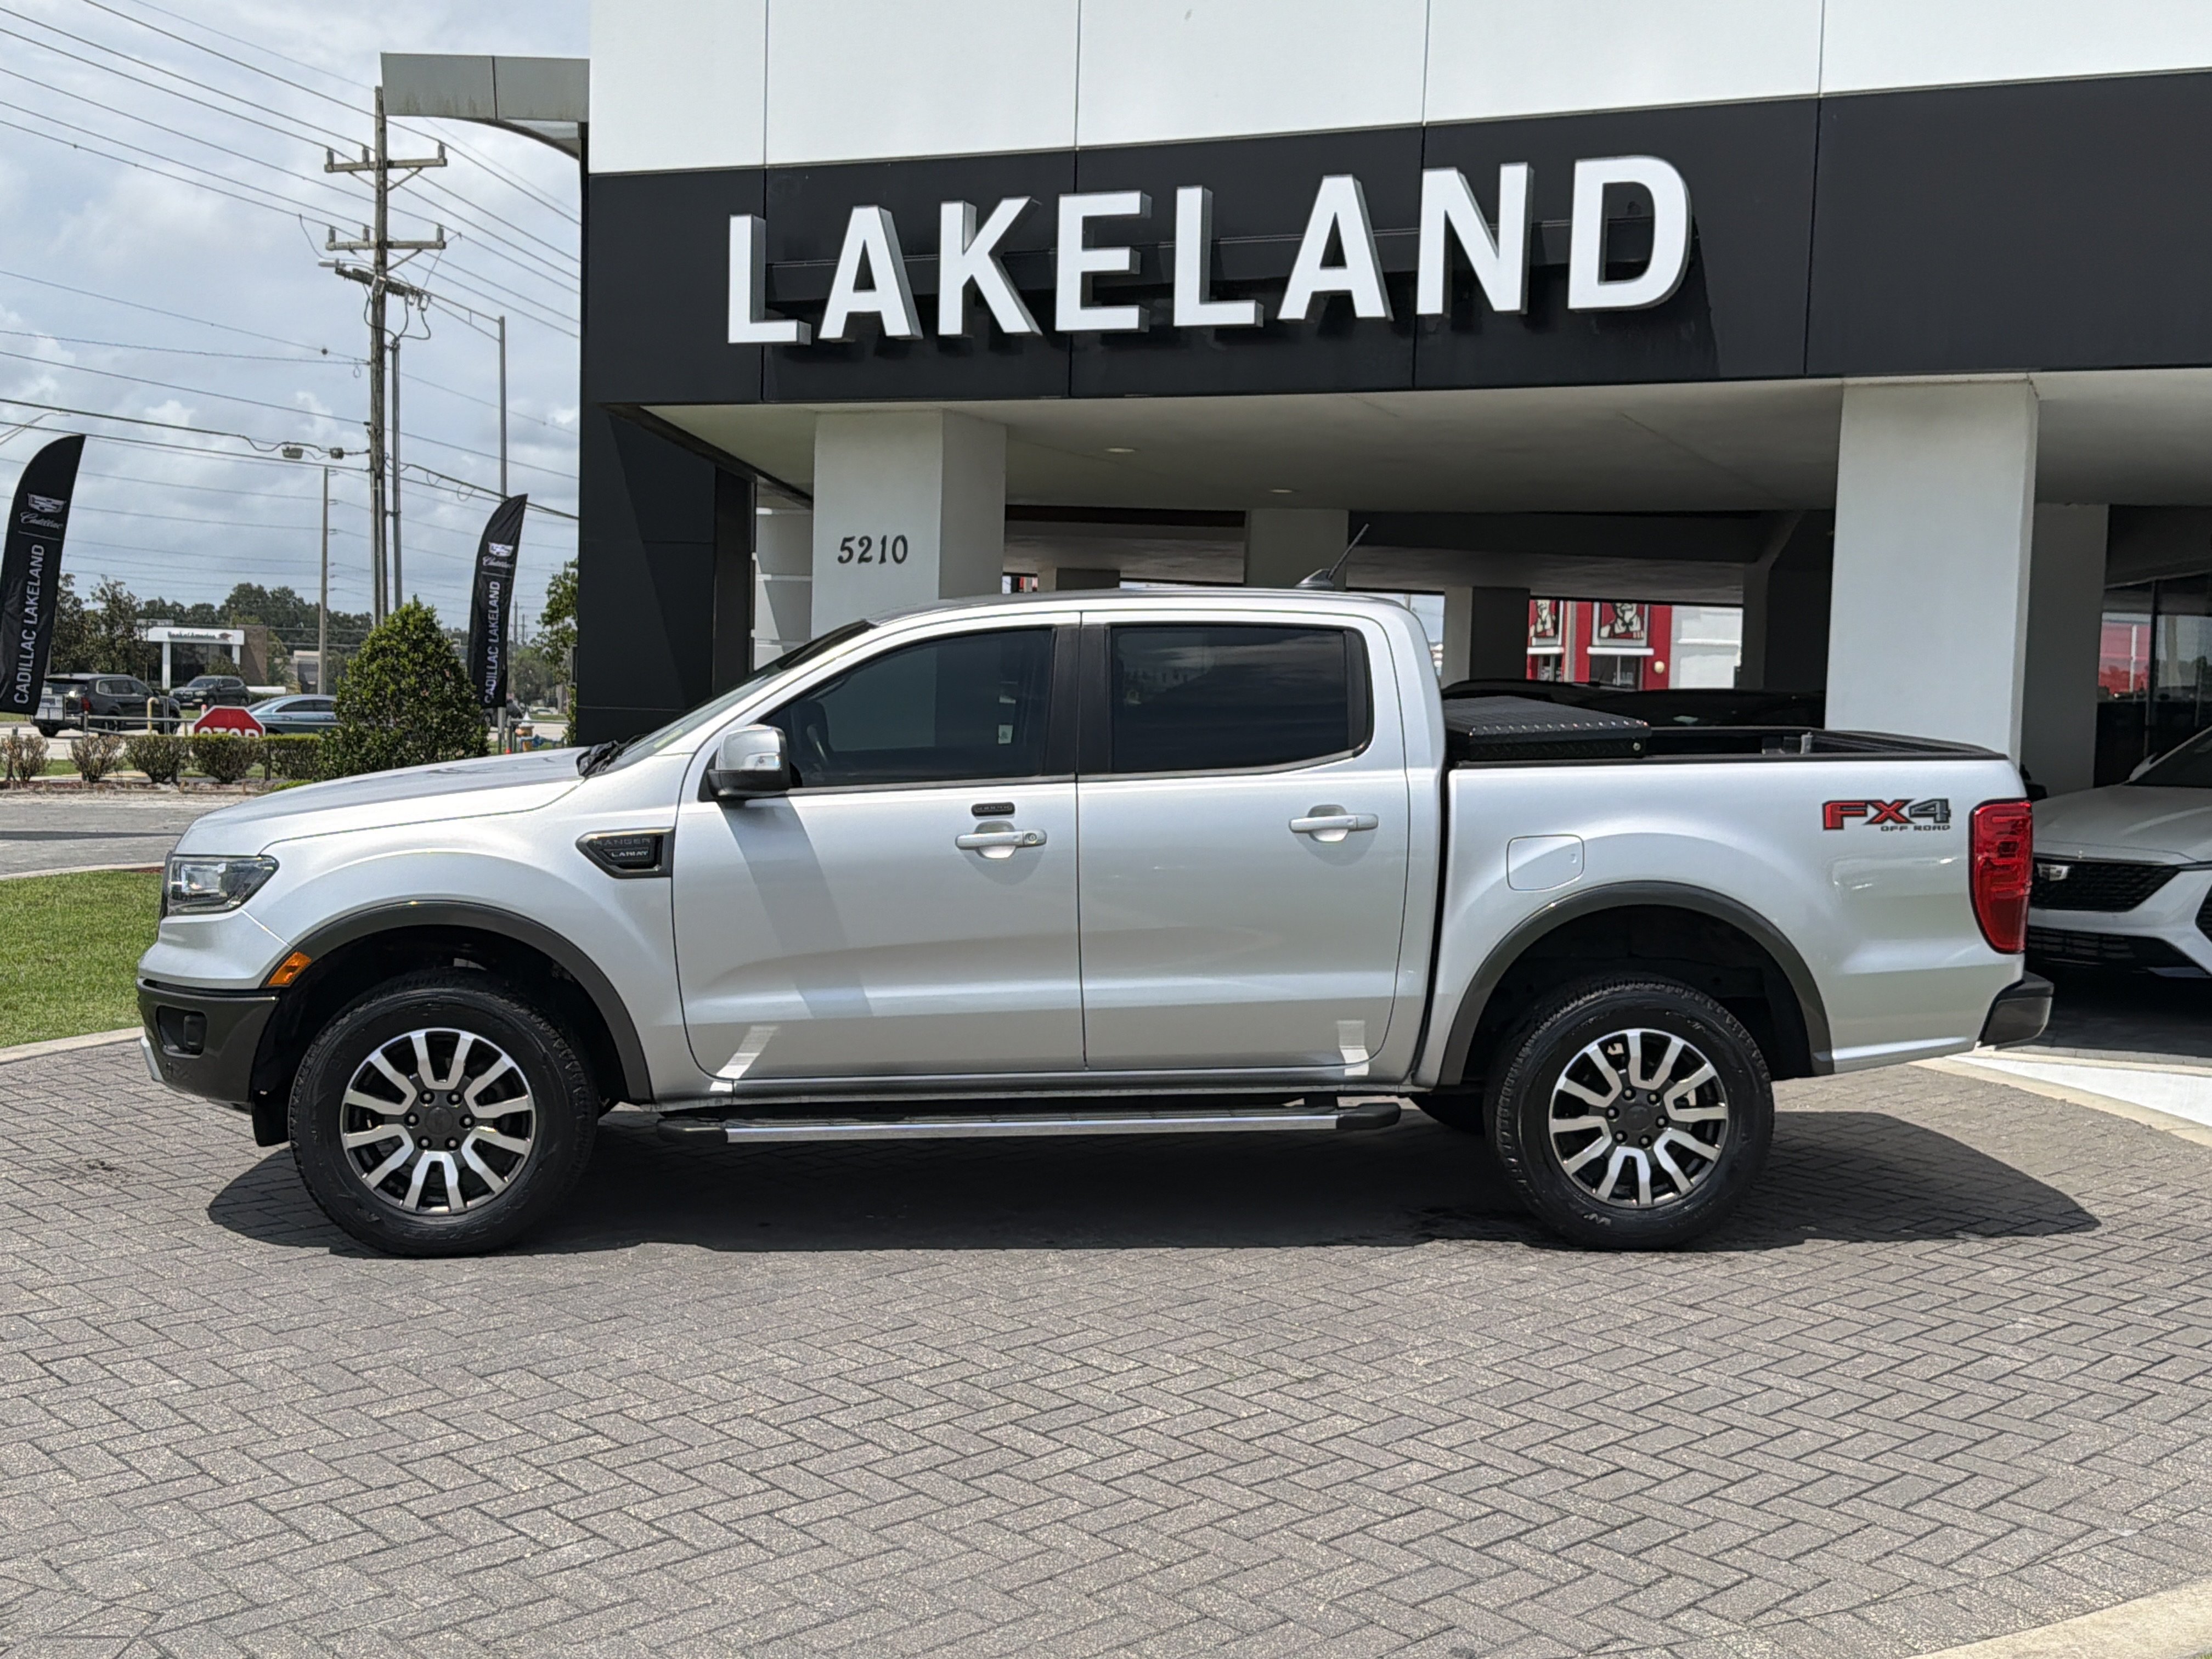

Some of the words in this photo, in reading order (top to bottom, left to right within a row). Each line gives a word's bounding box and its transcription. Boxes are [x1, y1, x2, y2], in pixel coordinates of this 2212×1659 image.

[728, 155, 1691, 345] LAKELAND
[838, 535, 908, 564] 5210
[24, 544, 44, 624] LAKELAND
[488, 581, 500, 643] LAKELAND
[14, 629, 36, 704] CADILLAC
[484, 646, 499, 704] CADILLAC
[1822, 799, 1951, 830] FX4
